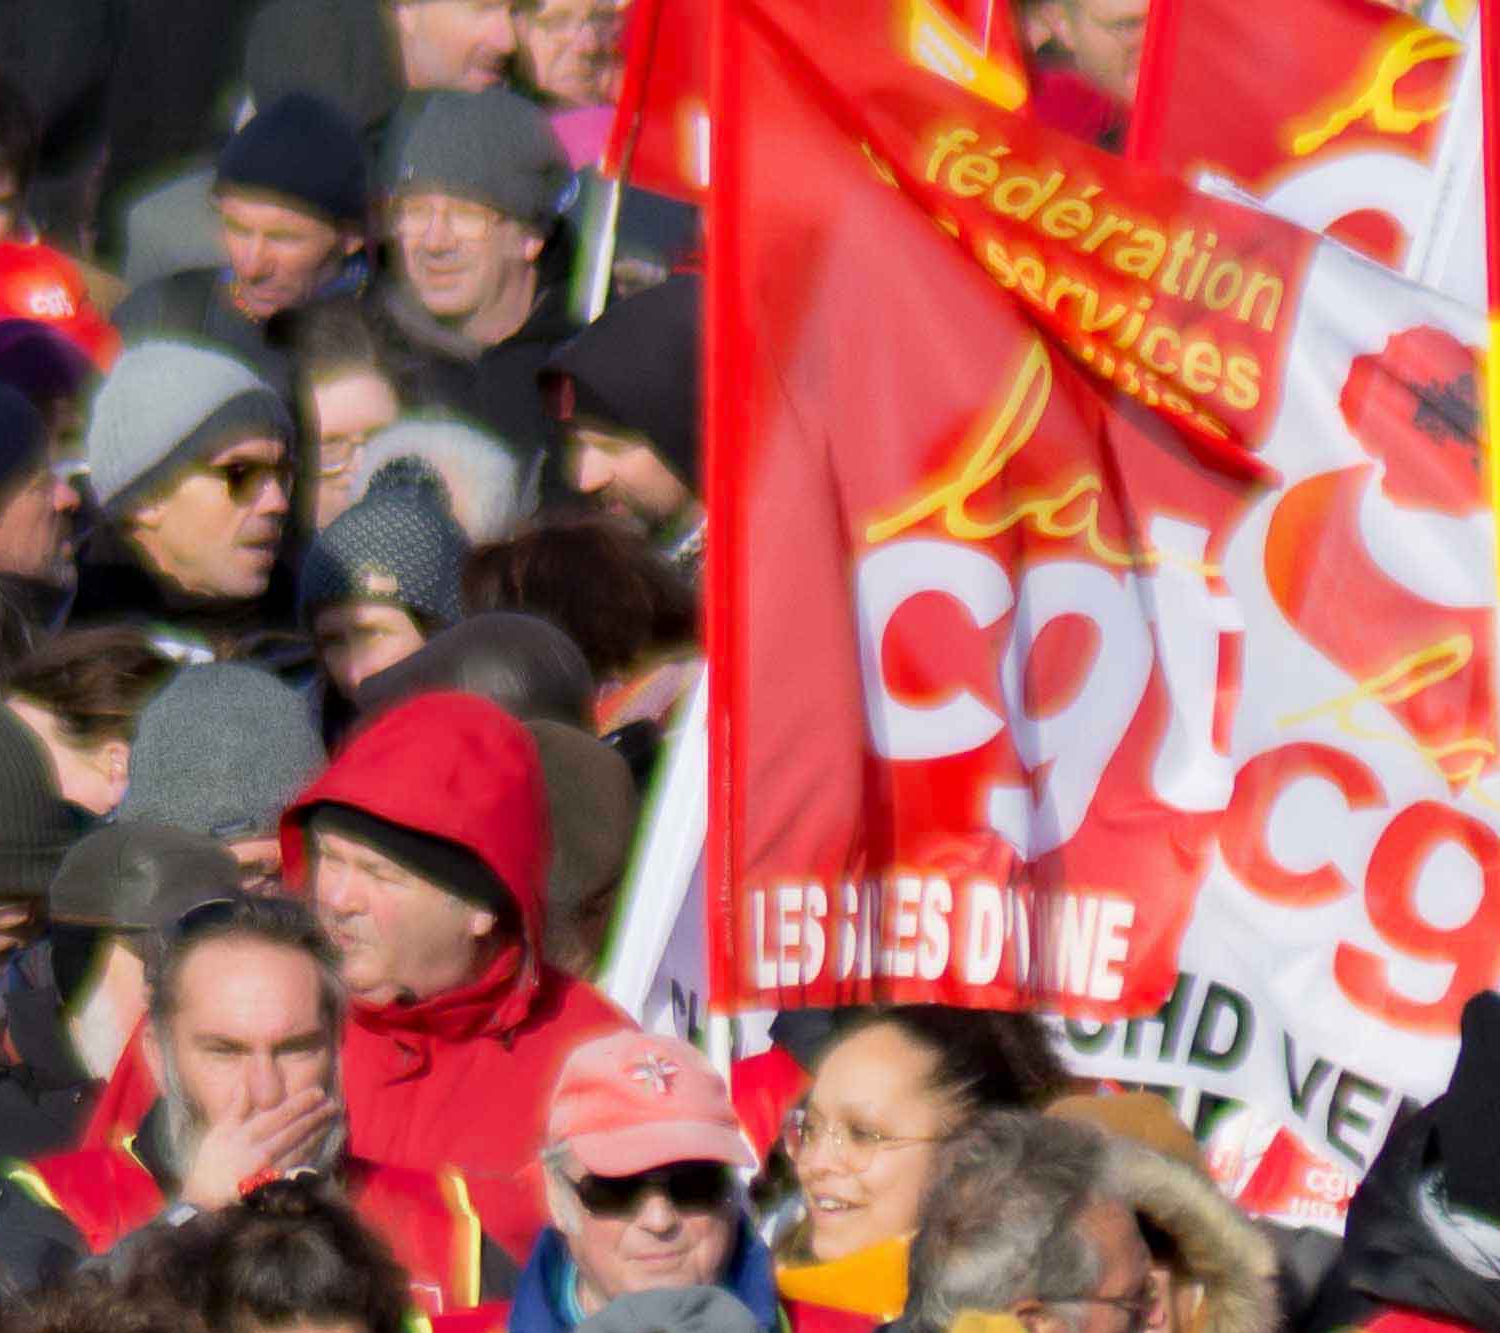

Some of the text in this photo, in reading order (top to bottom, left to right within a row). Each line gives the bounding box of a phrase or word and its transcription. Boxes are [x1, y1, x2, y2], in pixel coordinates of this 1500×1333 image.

[924, 127, 1286, 332] fédération
[986, 238, 1262, 412] services
[858, 513, 1247, 862] cgt
[754, 880, 828, 988] LES
